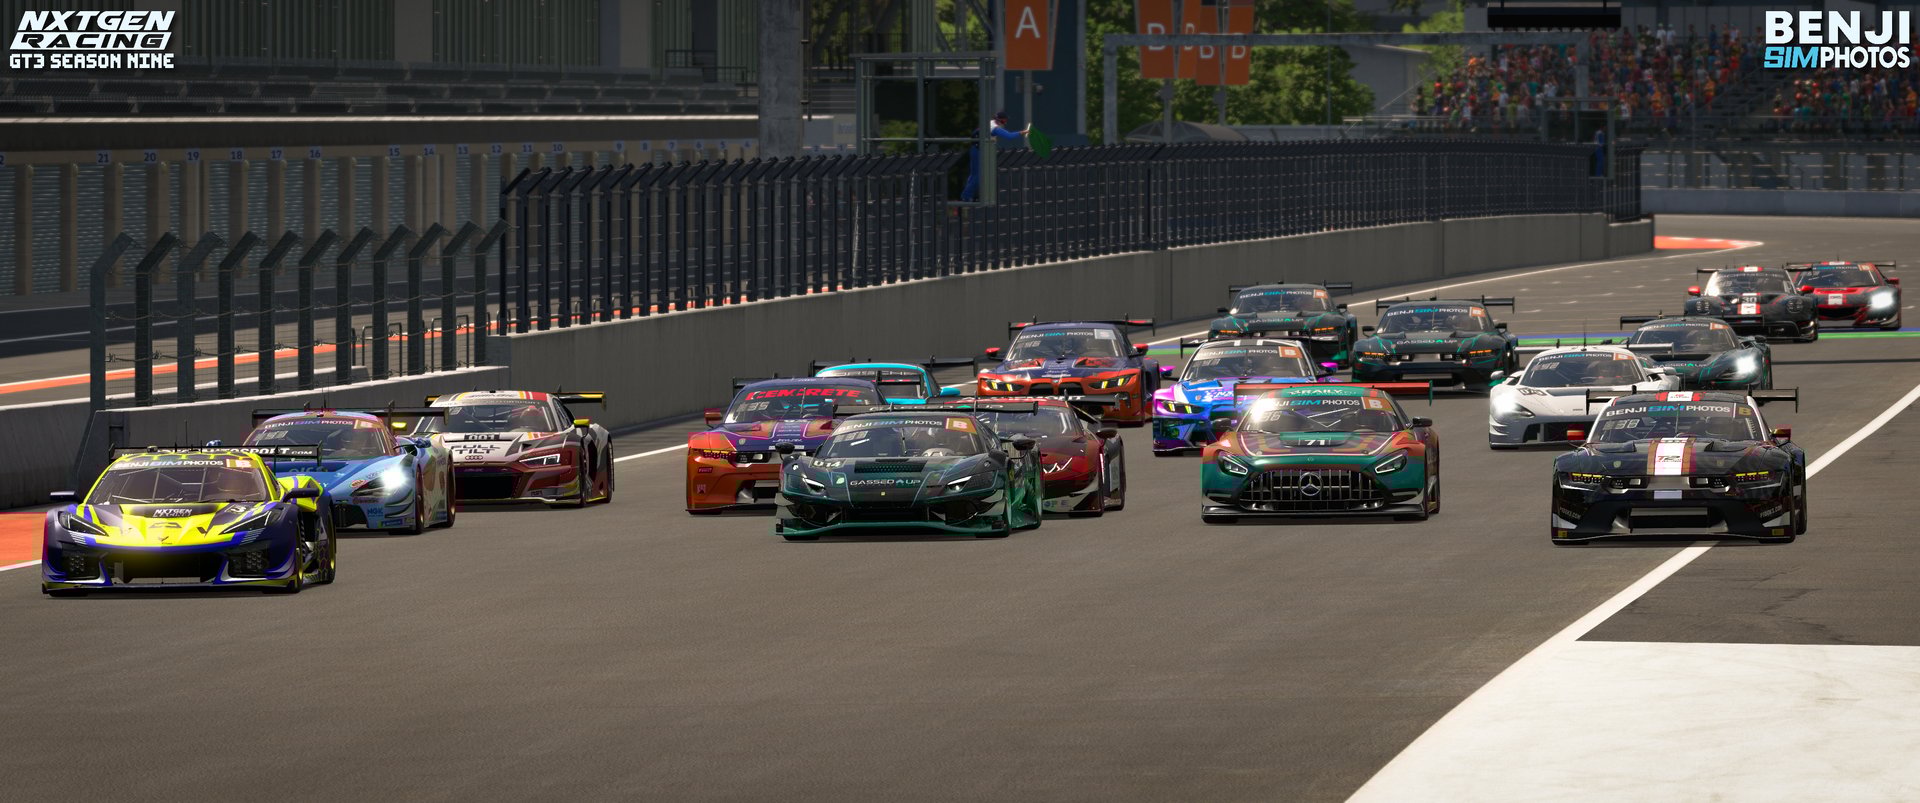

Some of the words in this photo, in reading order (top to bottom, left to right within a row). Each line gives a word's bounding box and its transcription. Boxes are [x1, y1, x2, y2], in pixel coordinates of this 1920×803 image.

[1015, 6, 1041, 38] A
[144, 152, 156, 162] 20
[187, 151, 199, 161] 19
[231, 150, 243, 160] 18
[271, 150, 282, 159] 17
[310, 149, 321, 158] 16
[389, 147, 400, 157] 15
[98, 153, 109, 163] 21
[1368, 399, 1384, 409] B
[1606, 406, 1647, 417] BENJI
[1685, 405, 1731, 413] PHOTOS
[1738, 406, 1751, 416] B
[838, 422, 872, 432] BENJI
[952, 420, 968, 429] B
[183, 458, 224, 466] PHOTOS
